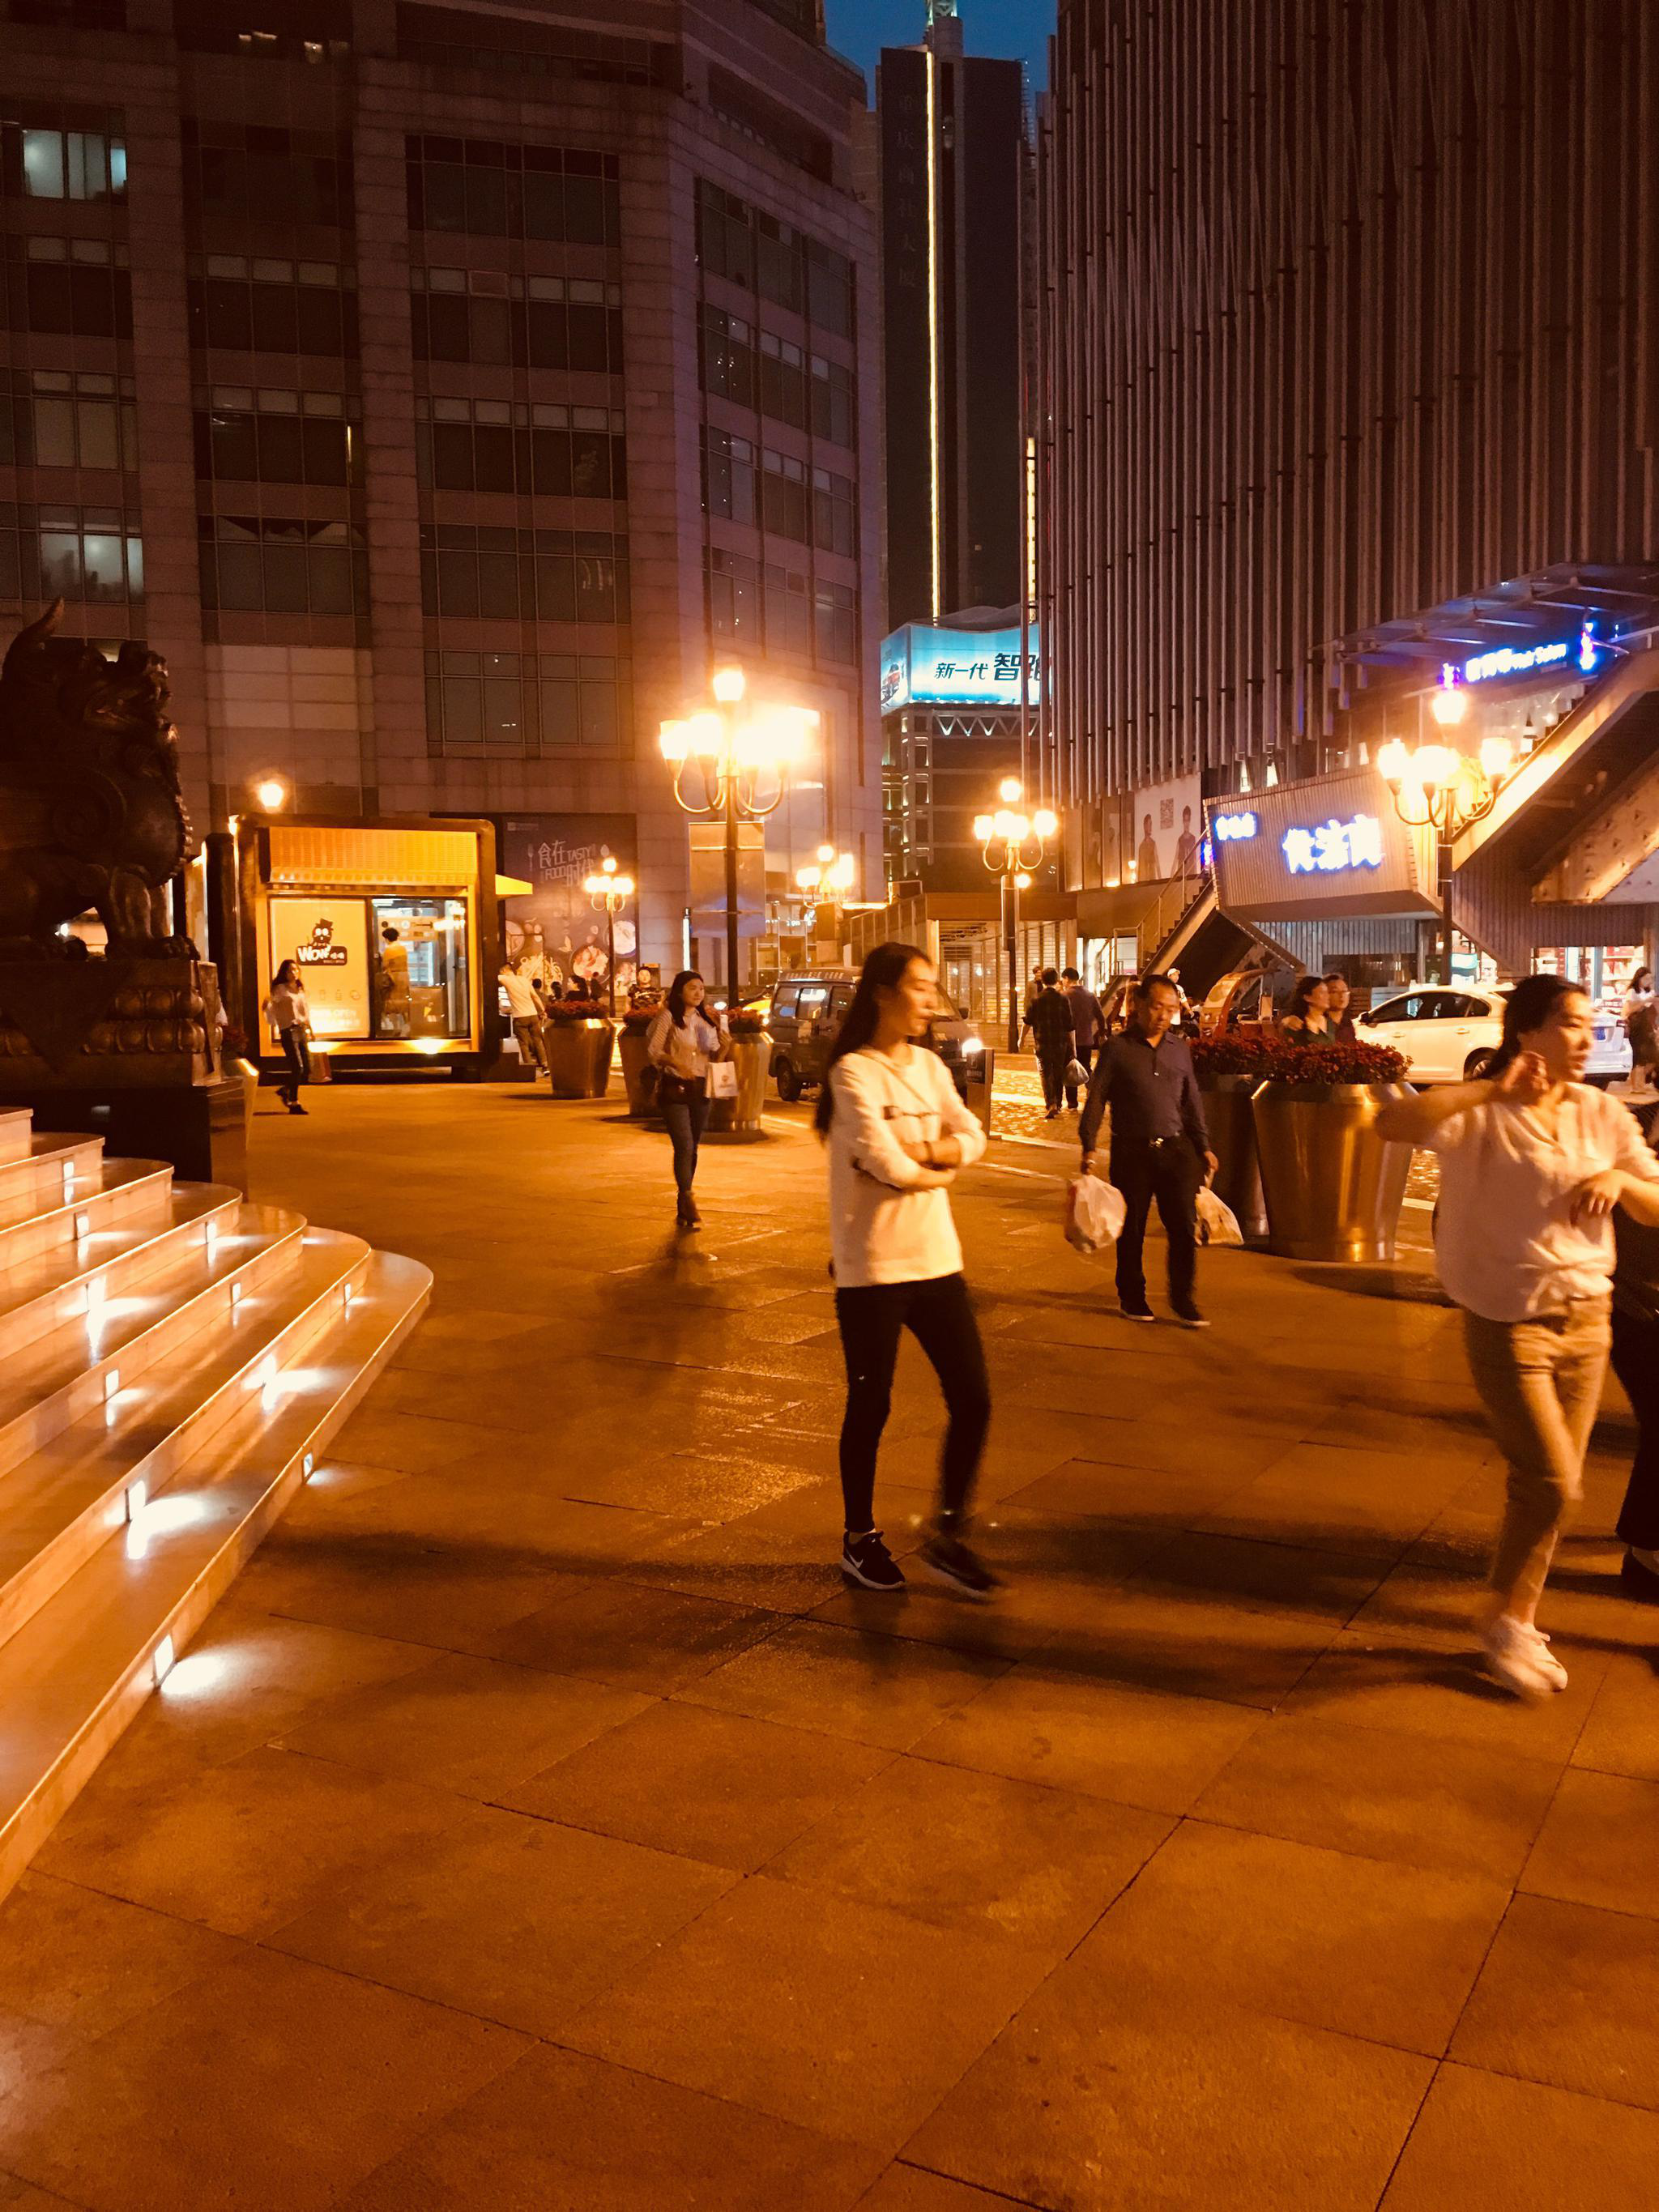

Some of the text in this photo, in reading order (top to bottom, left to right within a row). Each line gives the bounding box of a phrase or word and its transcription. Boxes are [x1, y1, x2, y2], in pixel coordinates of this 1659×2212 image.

[934, 662, 988, 680] 新一代
[538, 839, 591, 869] 食在 TASTY
[544, 866, 566, 881] FOOD
